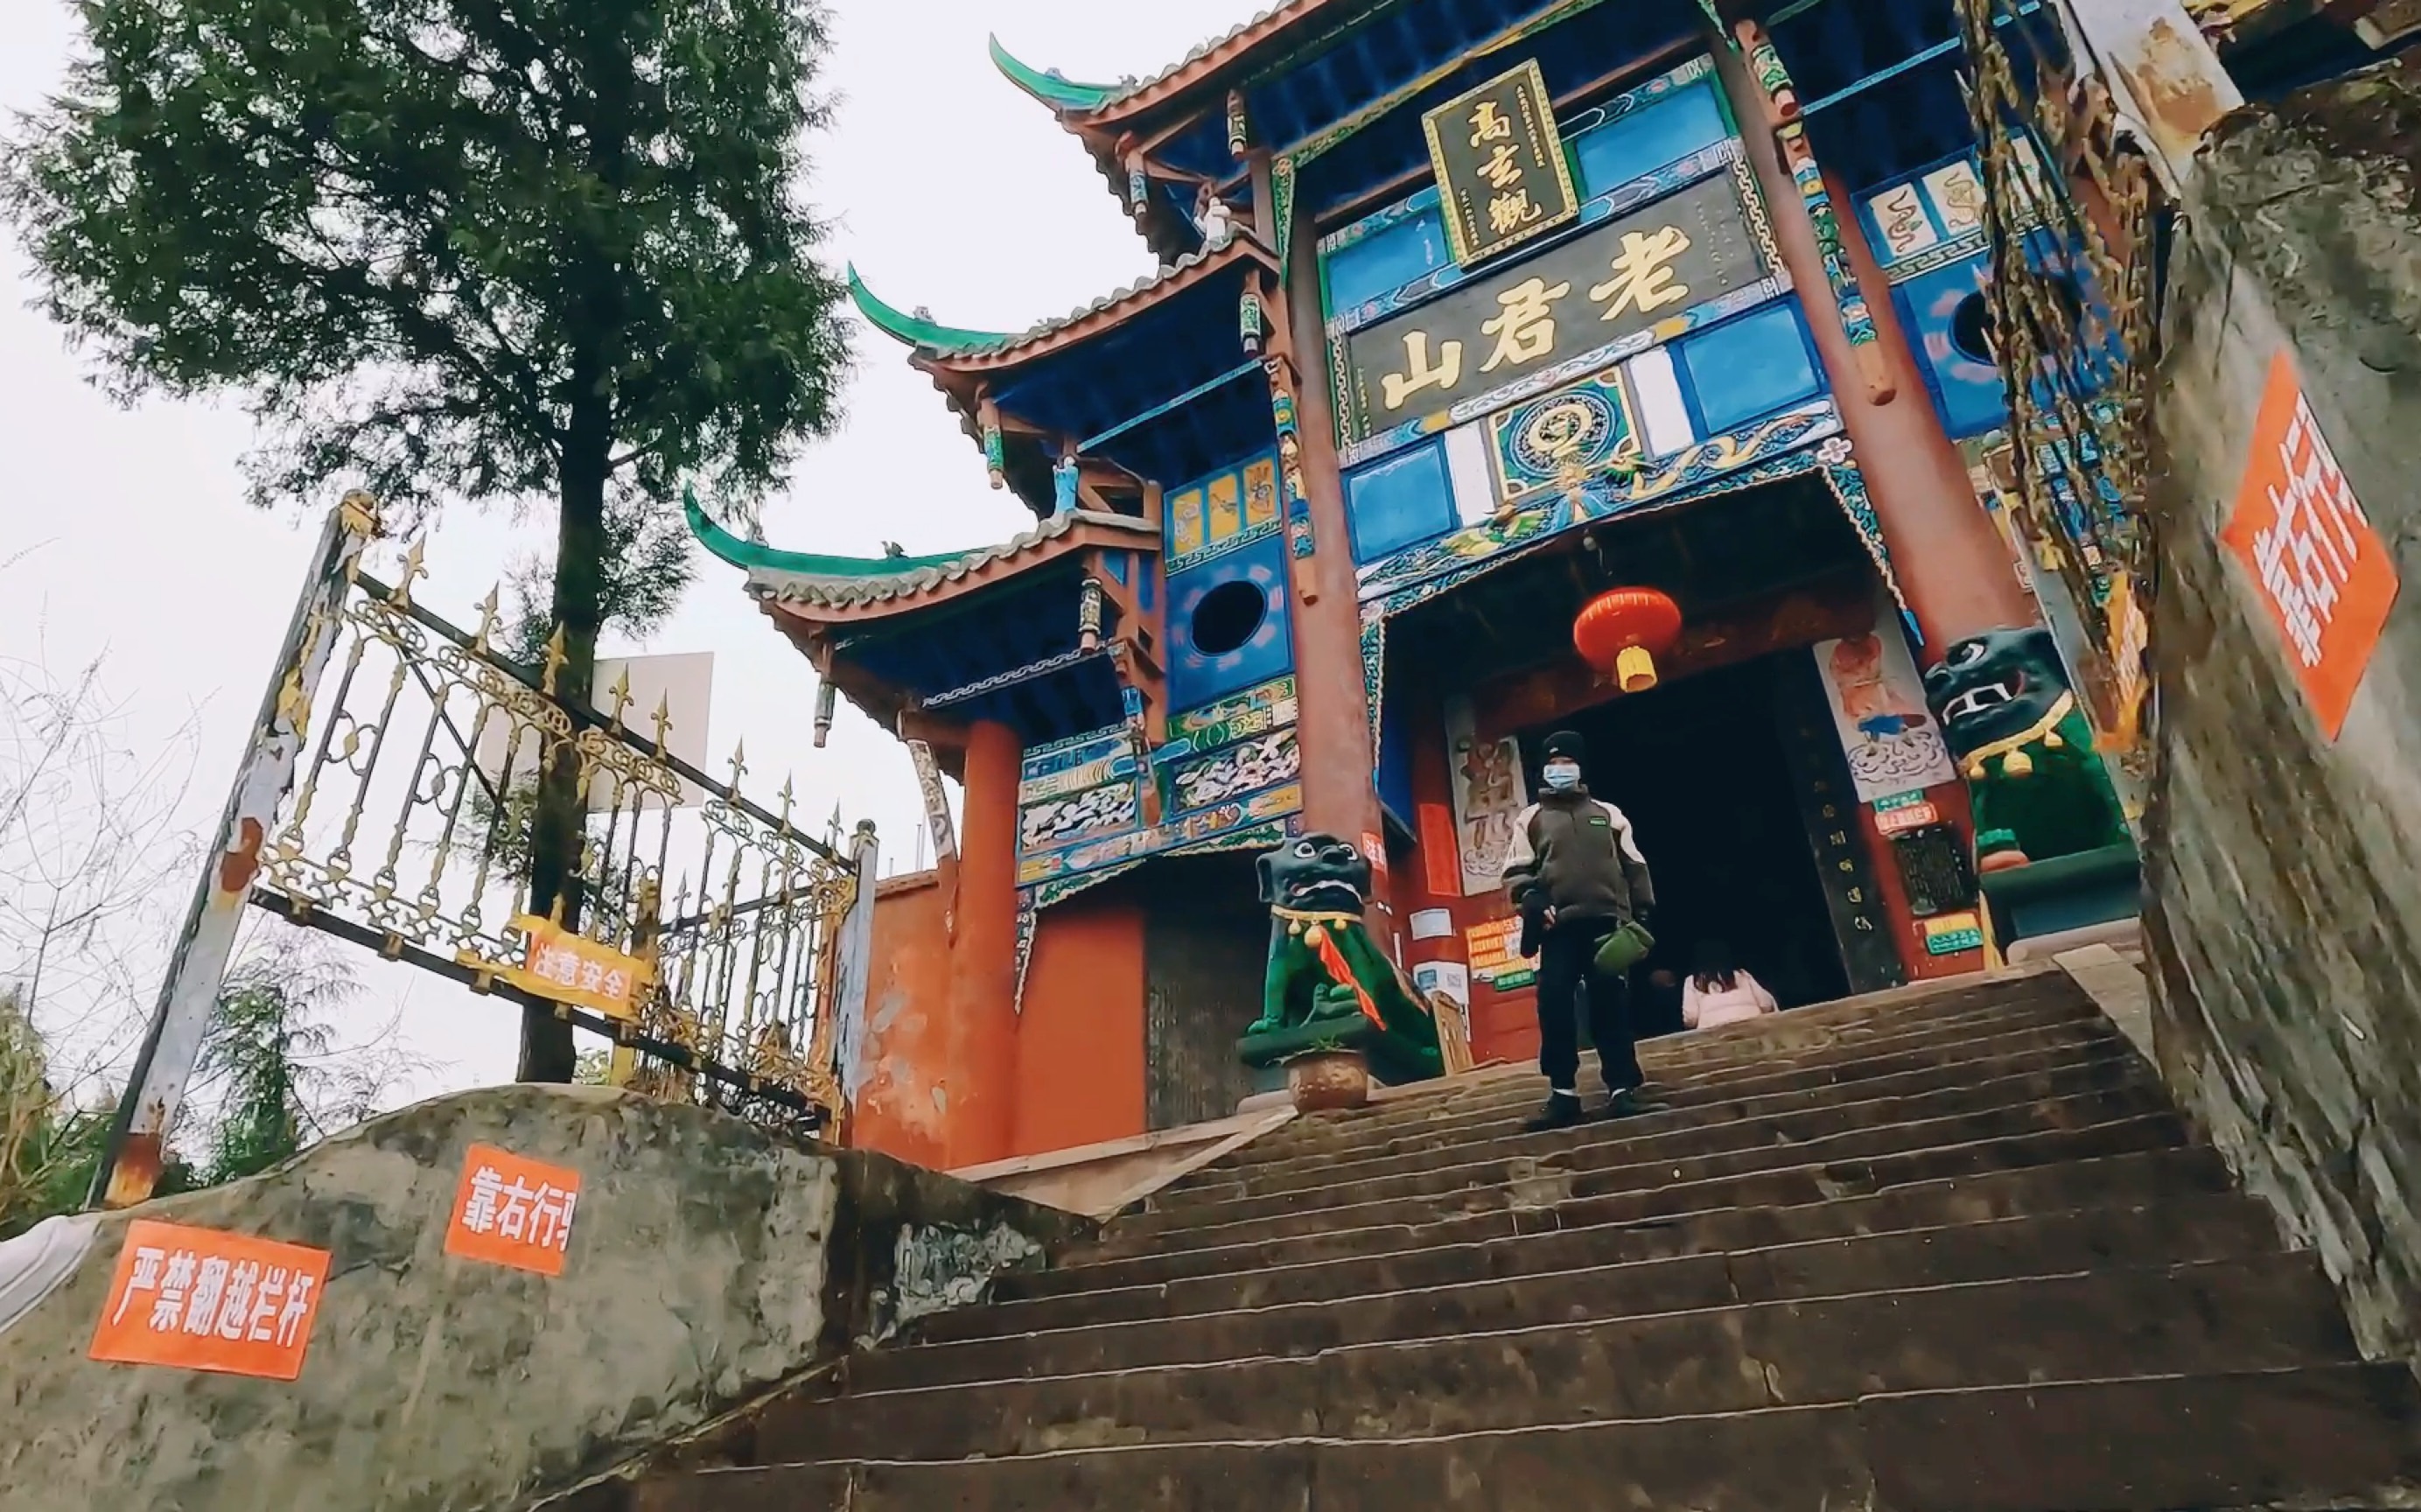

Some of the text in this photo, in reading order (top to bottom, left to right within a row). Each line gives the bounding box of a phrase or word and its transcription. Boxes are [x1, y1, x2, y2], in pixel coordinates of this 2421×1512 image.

[1381, 225, 1690, 410] 老君山
[534, 942, 623, 1000] 注意安全
[111, 1246, 315, 1348] 严禁翻越栏杆
